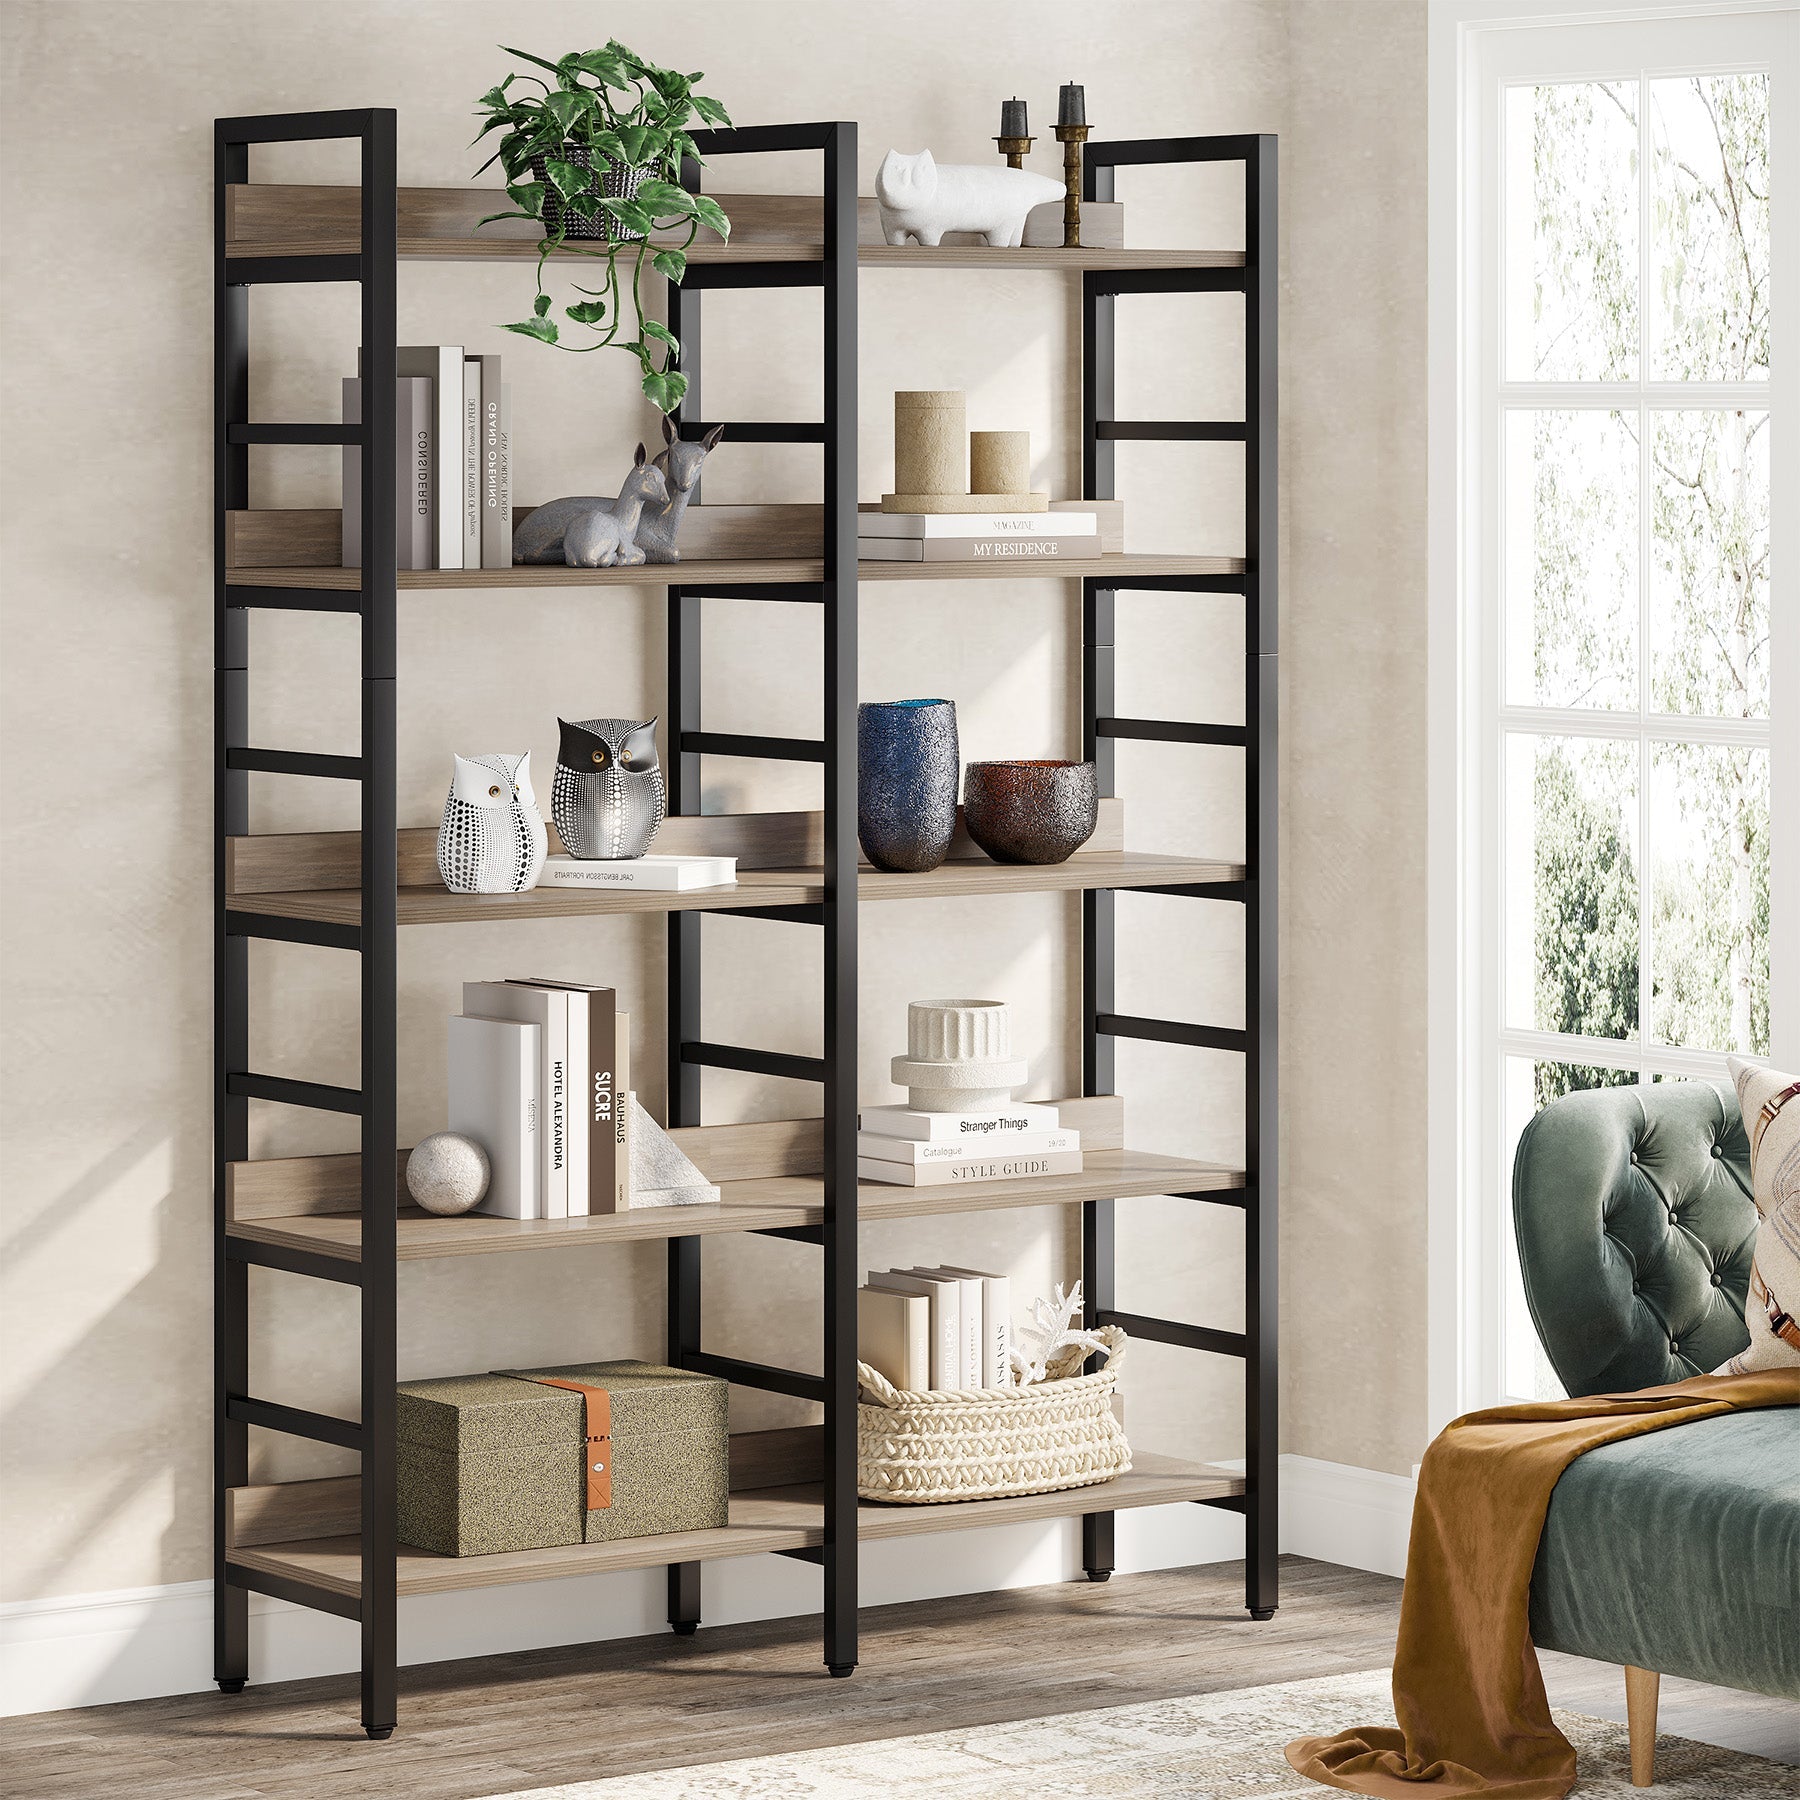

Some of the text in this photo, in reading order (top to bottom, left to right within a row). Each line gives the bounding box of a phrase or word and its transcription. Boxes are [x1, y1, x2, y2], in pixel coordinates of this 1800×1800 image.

[992, 520, 1035, 531] MAGAZINE
[973, 542, 1058, 556] MY RESIDENCE
[594, 1071, 611, 1122] SUCRE
[554, 1061, 563, 1170] HOTEL ALEXANDRA
[616, 1092, 626, 1144] BAUHAUS
[960, 1118, 1028, 1133] Stranger Things
[923, 1146, 962, 1158] Catalogue
[952, 1160, 1049, 1179] STYLE GUIDE
